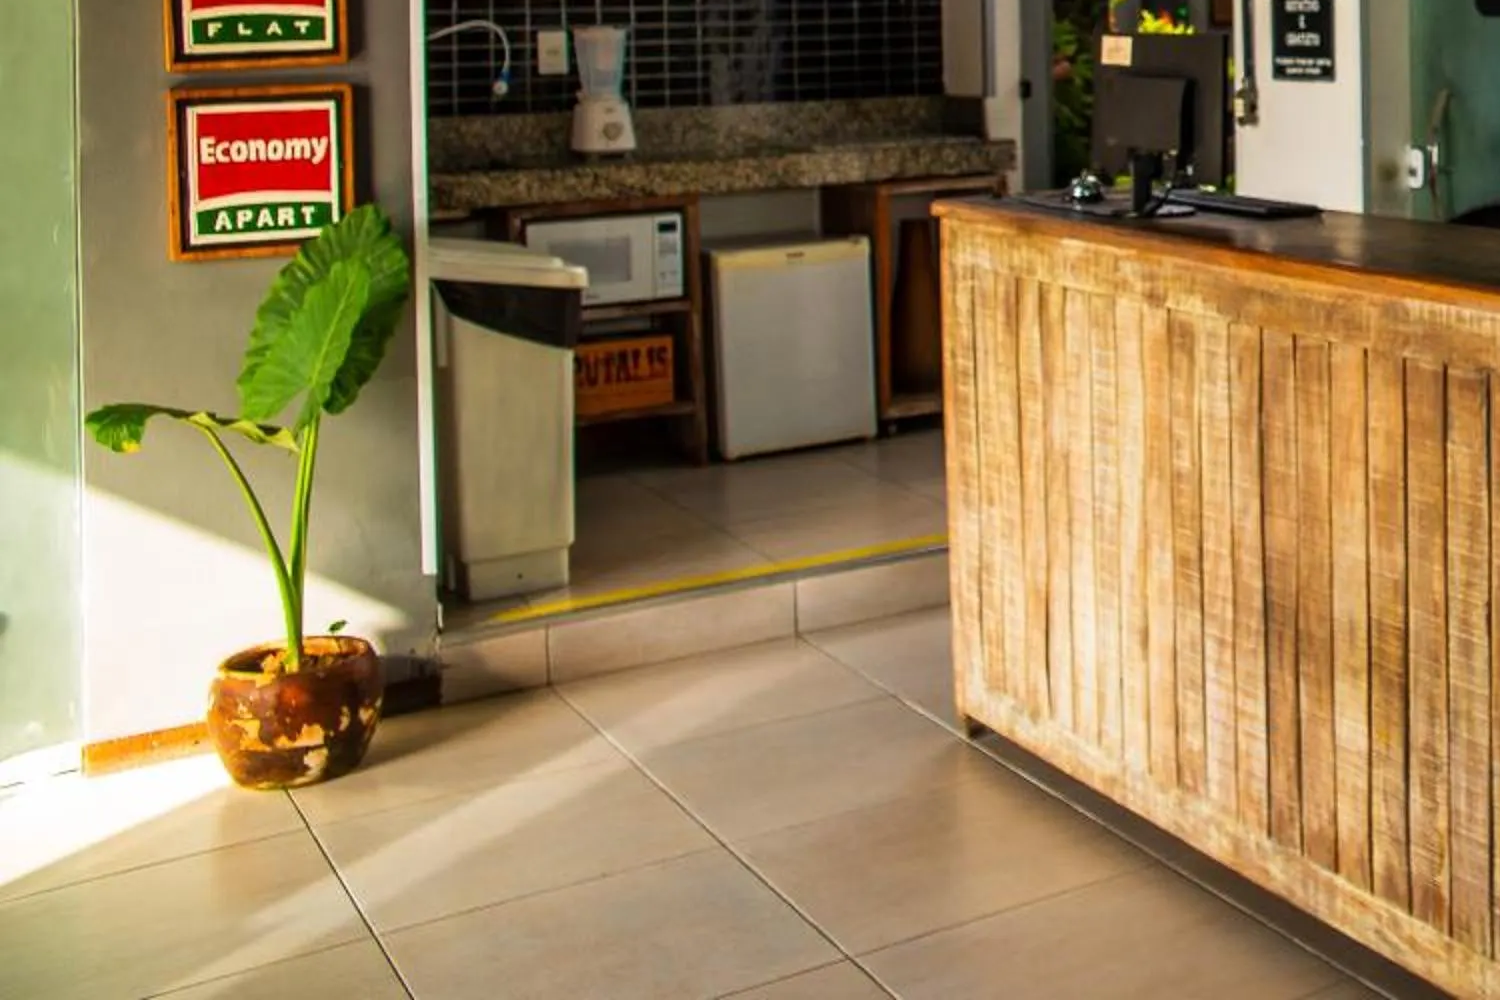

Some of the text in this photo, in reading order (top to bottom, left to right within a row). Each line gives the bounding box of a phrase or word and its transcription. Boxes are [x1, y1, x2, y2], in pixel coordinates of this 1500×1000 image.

[206, 20, 312, 38] FLAT
[200, 134, 330, 165] Economy
[214, 205, 318, 233] APART
